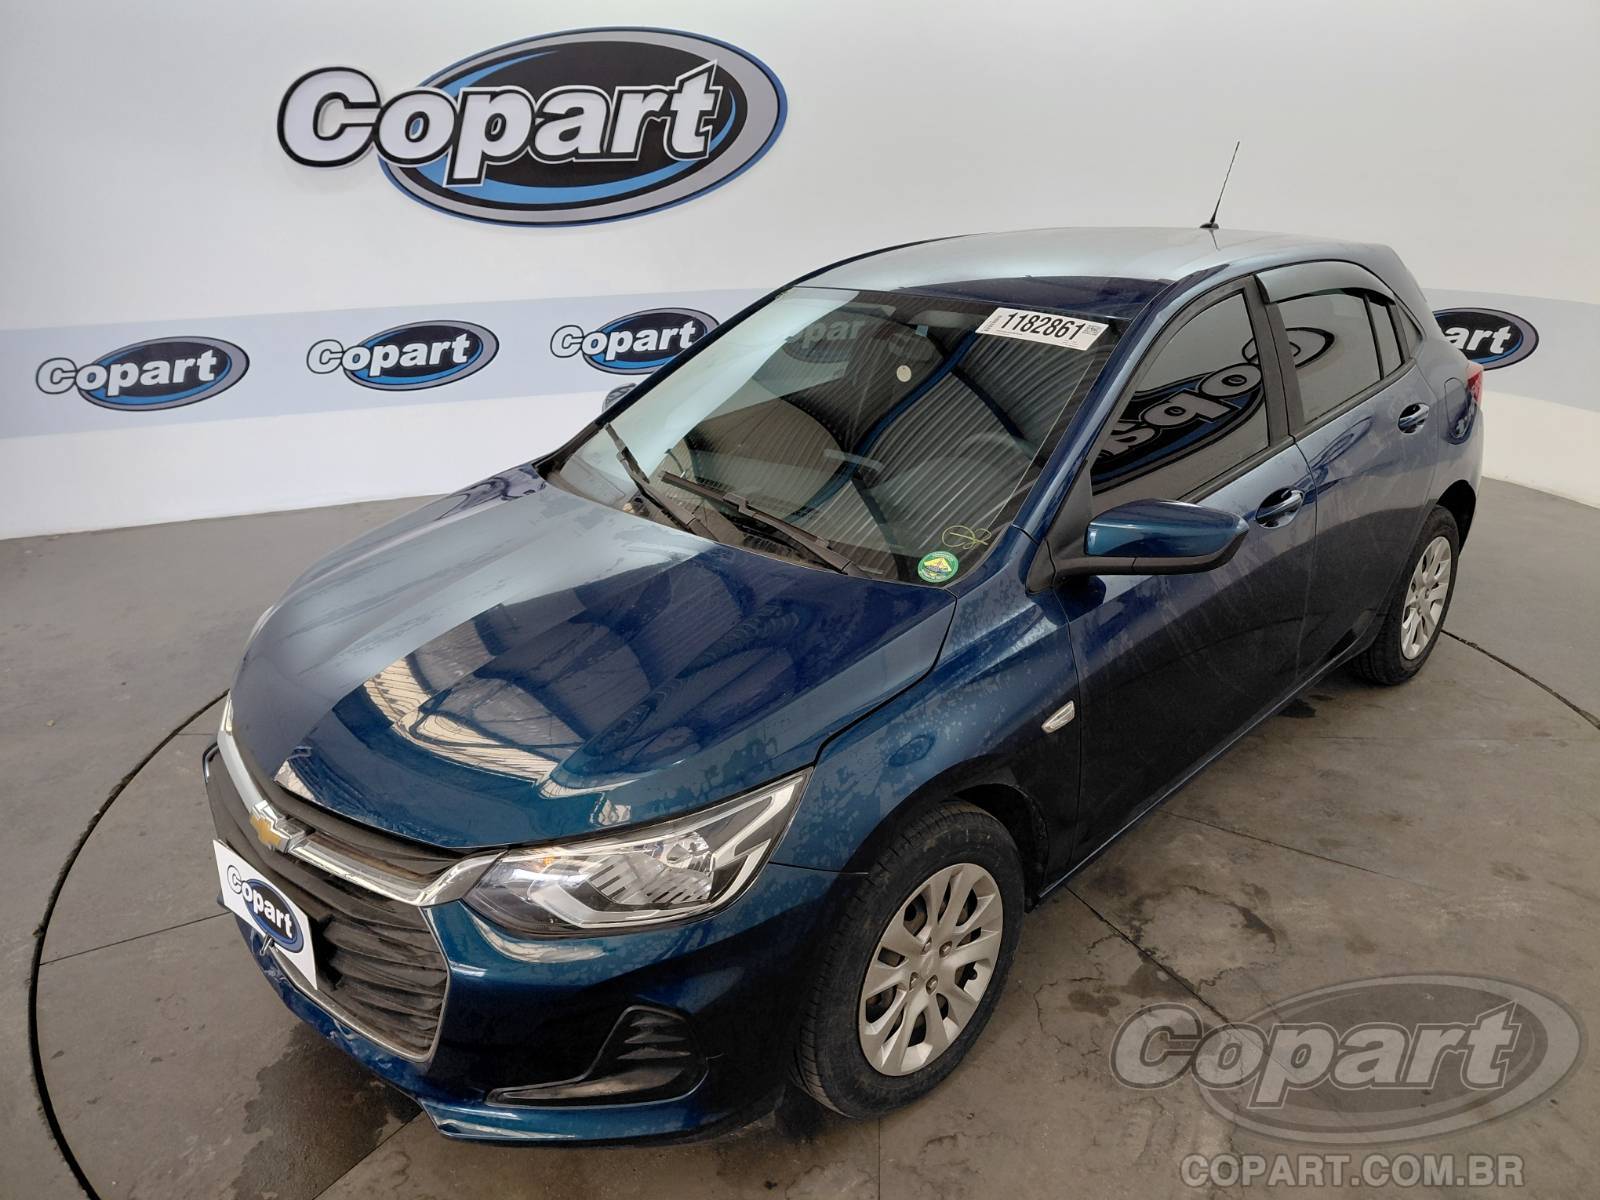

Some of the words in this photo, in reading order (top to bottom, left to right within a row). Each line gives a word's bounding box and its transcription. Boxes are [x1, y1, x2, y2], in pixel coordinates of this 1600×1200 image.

[276, 61, 723, 187] Copart
[550, 320, 695, 361] Copart
[1001, 312, 1086, 340] 1182861
[1443, 325, 1512, 354] art
[36, 349, 217, 397] Copart
[306, 333, 470, 377] Copart
[227, 864, 294, 939] Copart
